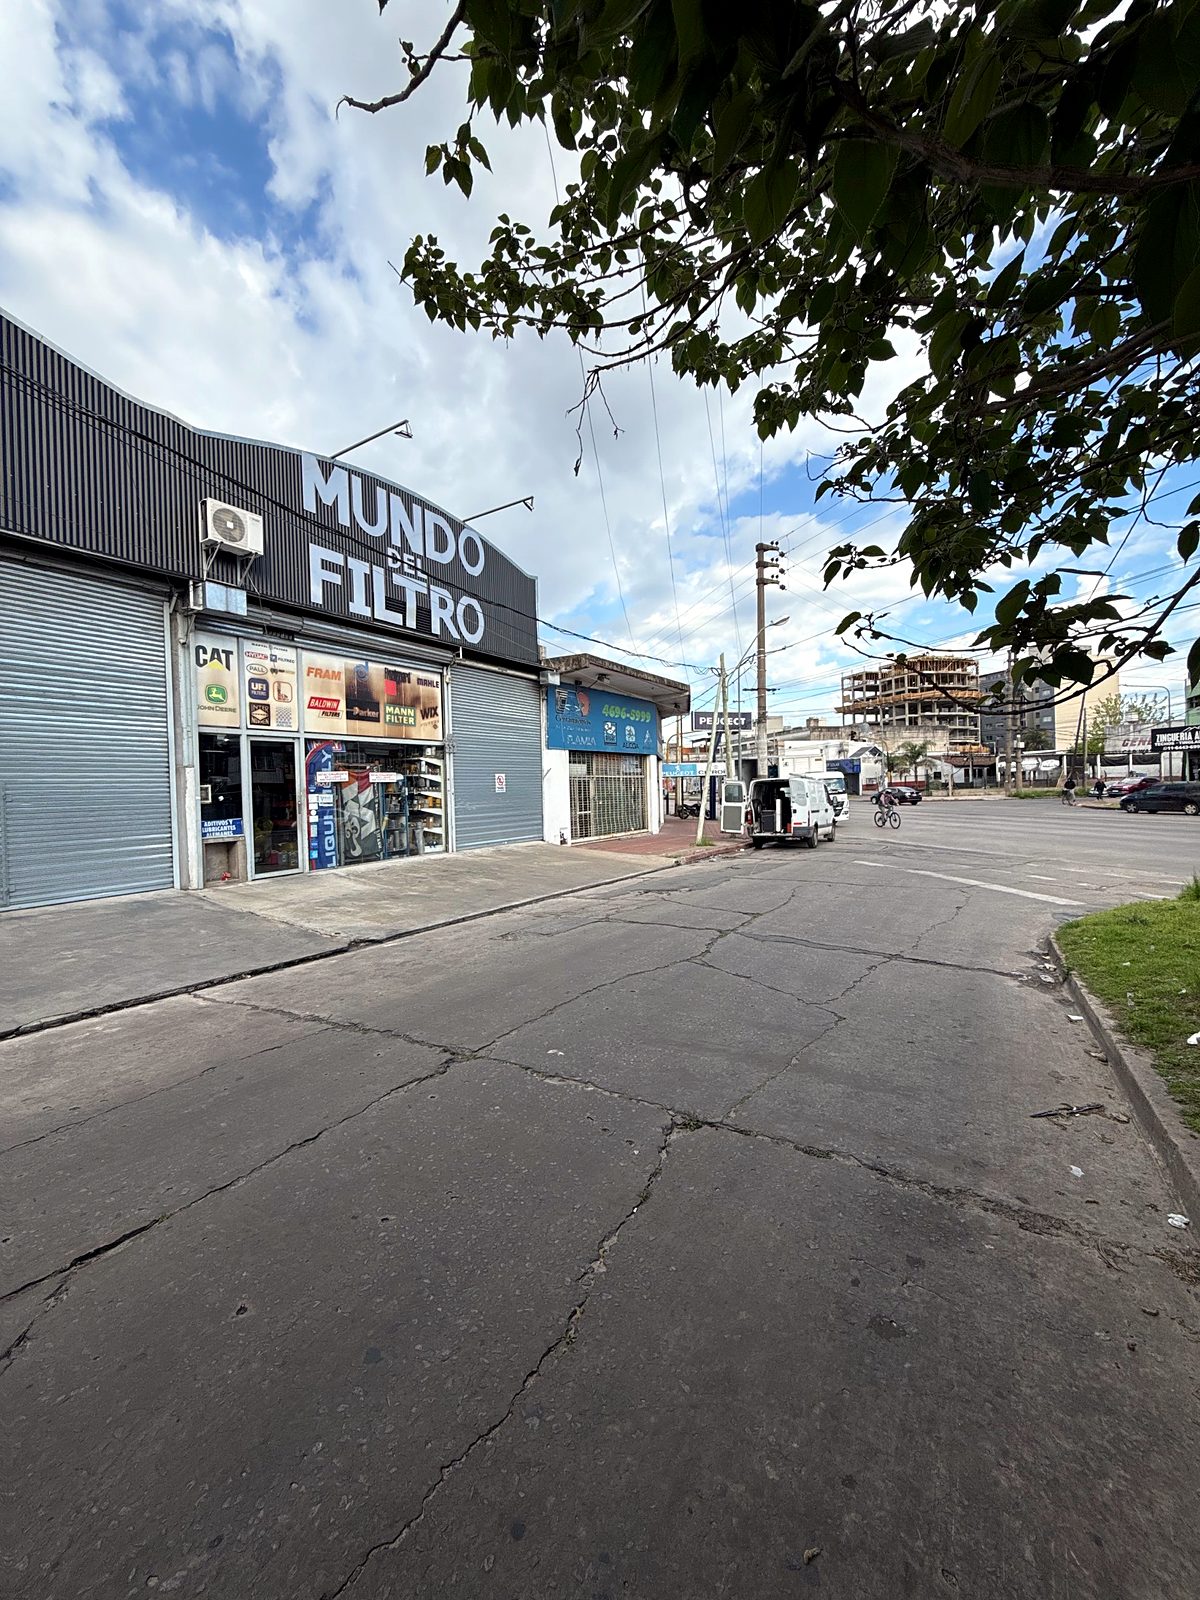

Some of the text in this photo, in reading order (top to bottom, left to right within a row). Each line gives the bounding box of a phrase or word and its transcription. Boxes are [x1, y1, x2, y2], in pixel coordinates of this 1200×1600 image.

[302, 450, 485, 577] MUNDO
[387, 547, 428, 580] DEL
[309, 542, 485, 644] FILTRO
[195, 645, 234, 671] CAT
[306, 666, 342, 681] FRAM
[251, 682, 266, 691] UFI
[417, 677, 440, 688] MAHLE
[215, 705, 237, 713] DEERE
[309, 698, 338, 709] BALDWIN
[321, 710, 341, 718] FILTERS
[353, 707, 379, 718] Parker
[385, 705, 415, 717] MANN
[420, 705, 439, 720] WIX
[602, 704, 652, 723] 4696-5999
[386, 716, 415, 725] FILTER
[1156, 731, 1193, 742] ZINGUERIA
[323, 815, 337, 867] LIQUI
